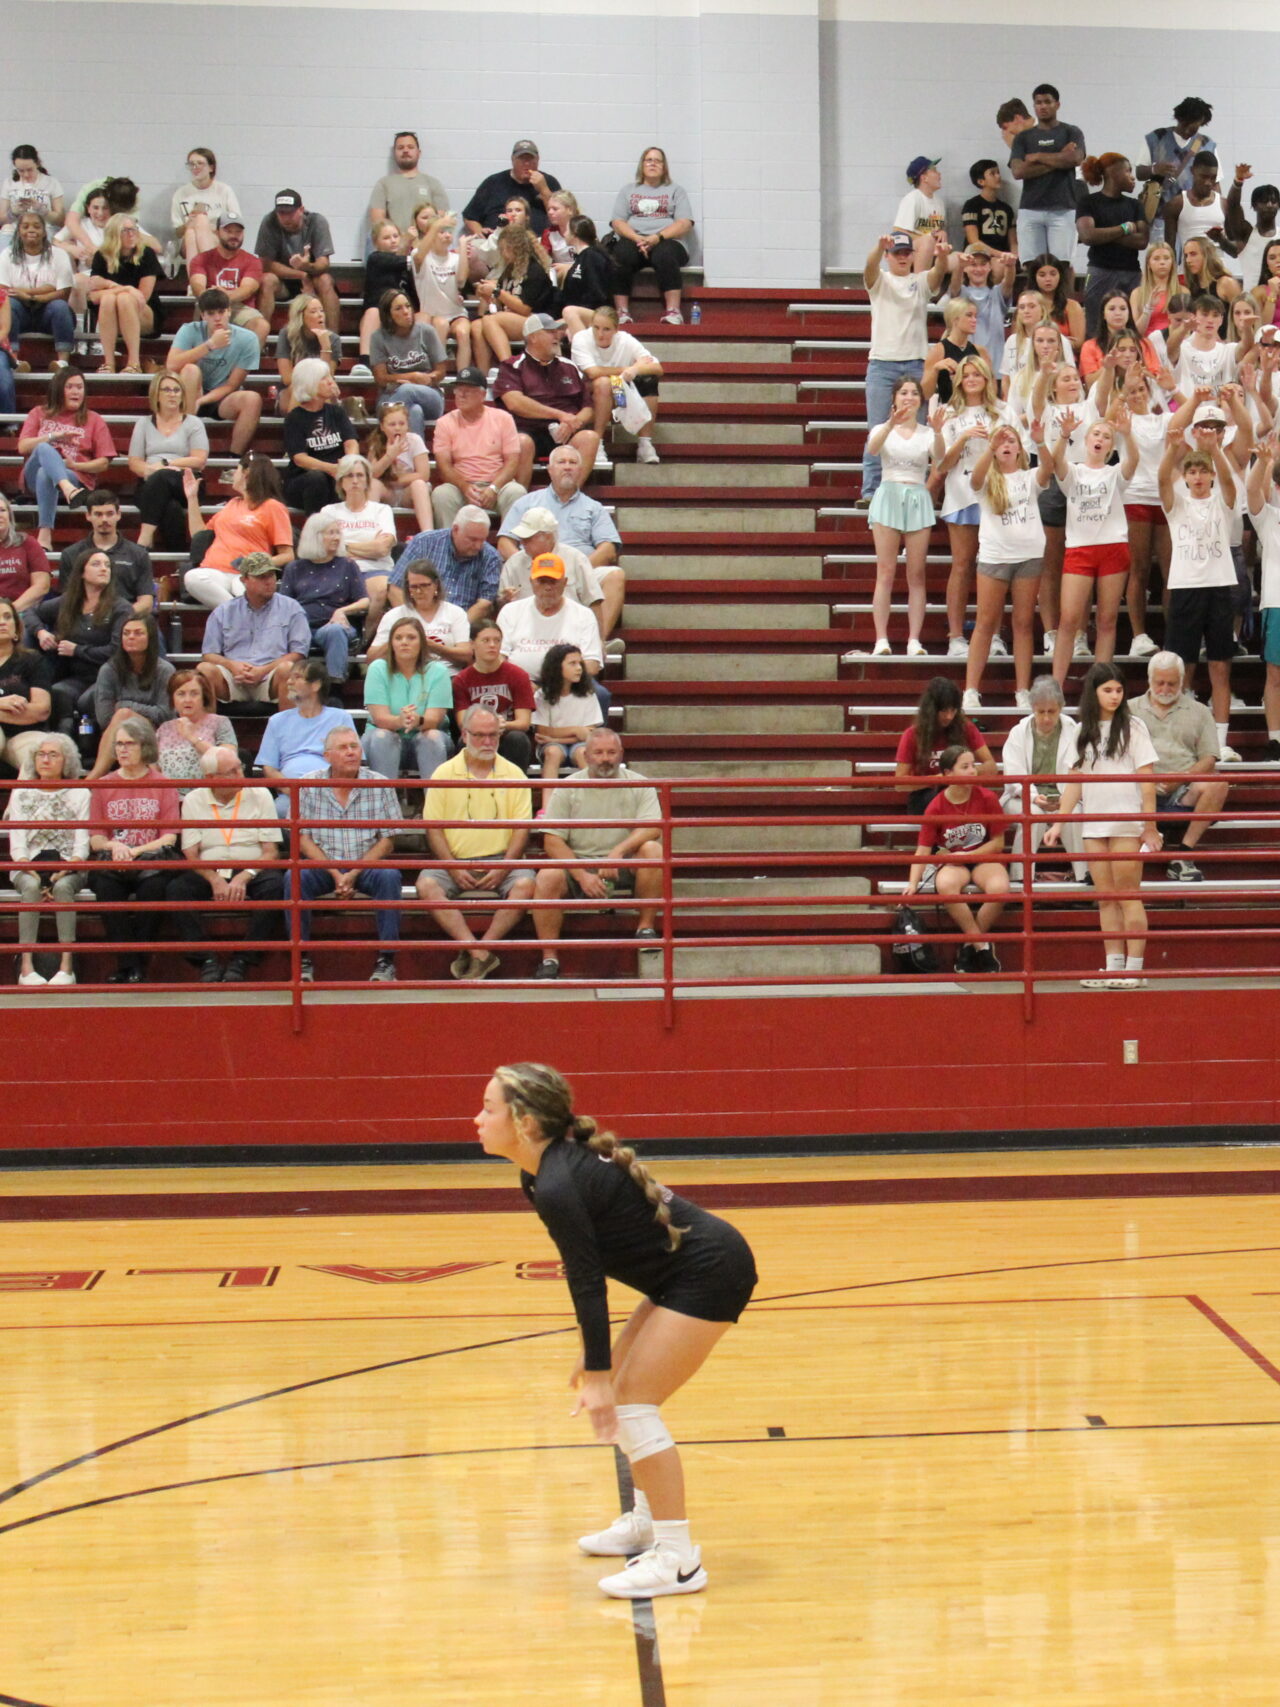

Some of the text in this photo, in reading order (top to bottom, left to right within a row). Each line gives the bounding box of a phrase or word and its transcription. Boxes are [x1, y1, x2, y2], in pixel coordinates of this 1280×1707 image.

[982, 208, 1007, 236] 23
[1002, 508, 1028, 526] BMW
[1177, 541, 1222, 561] TRUCKS
[468, 683, 513, 703] ALEDONIA
